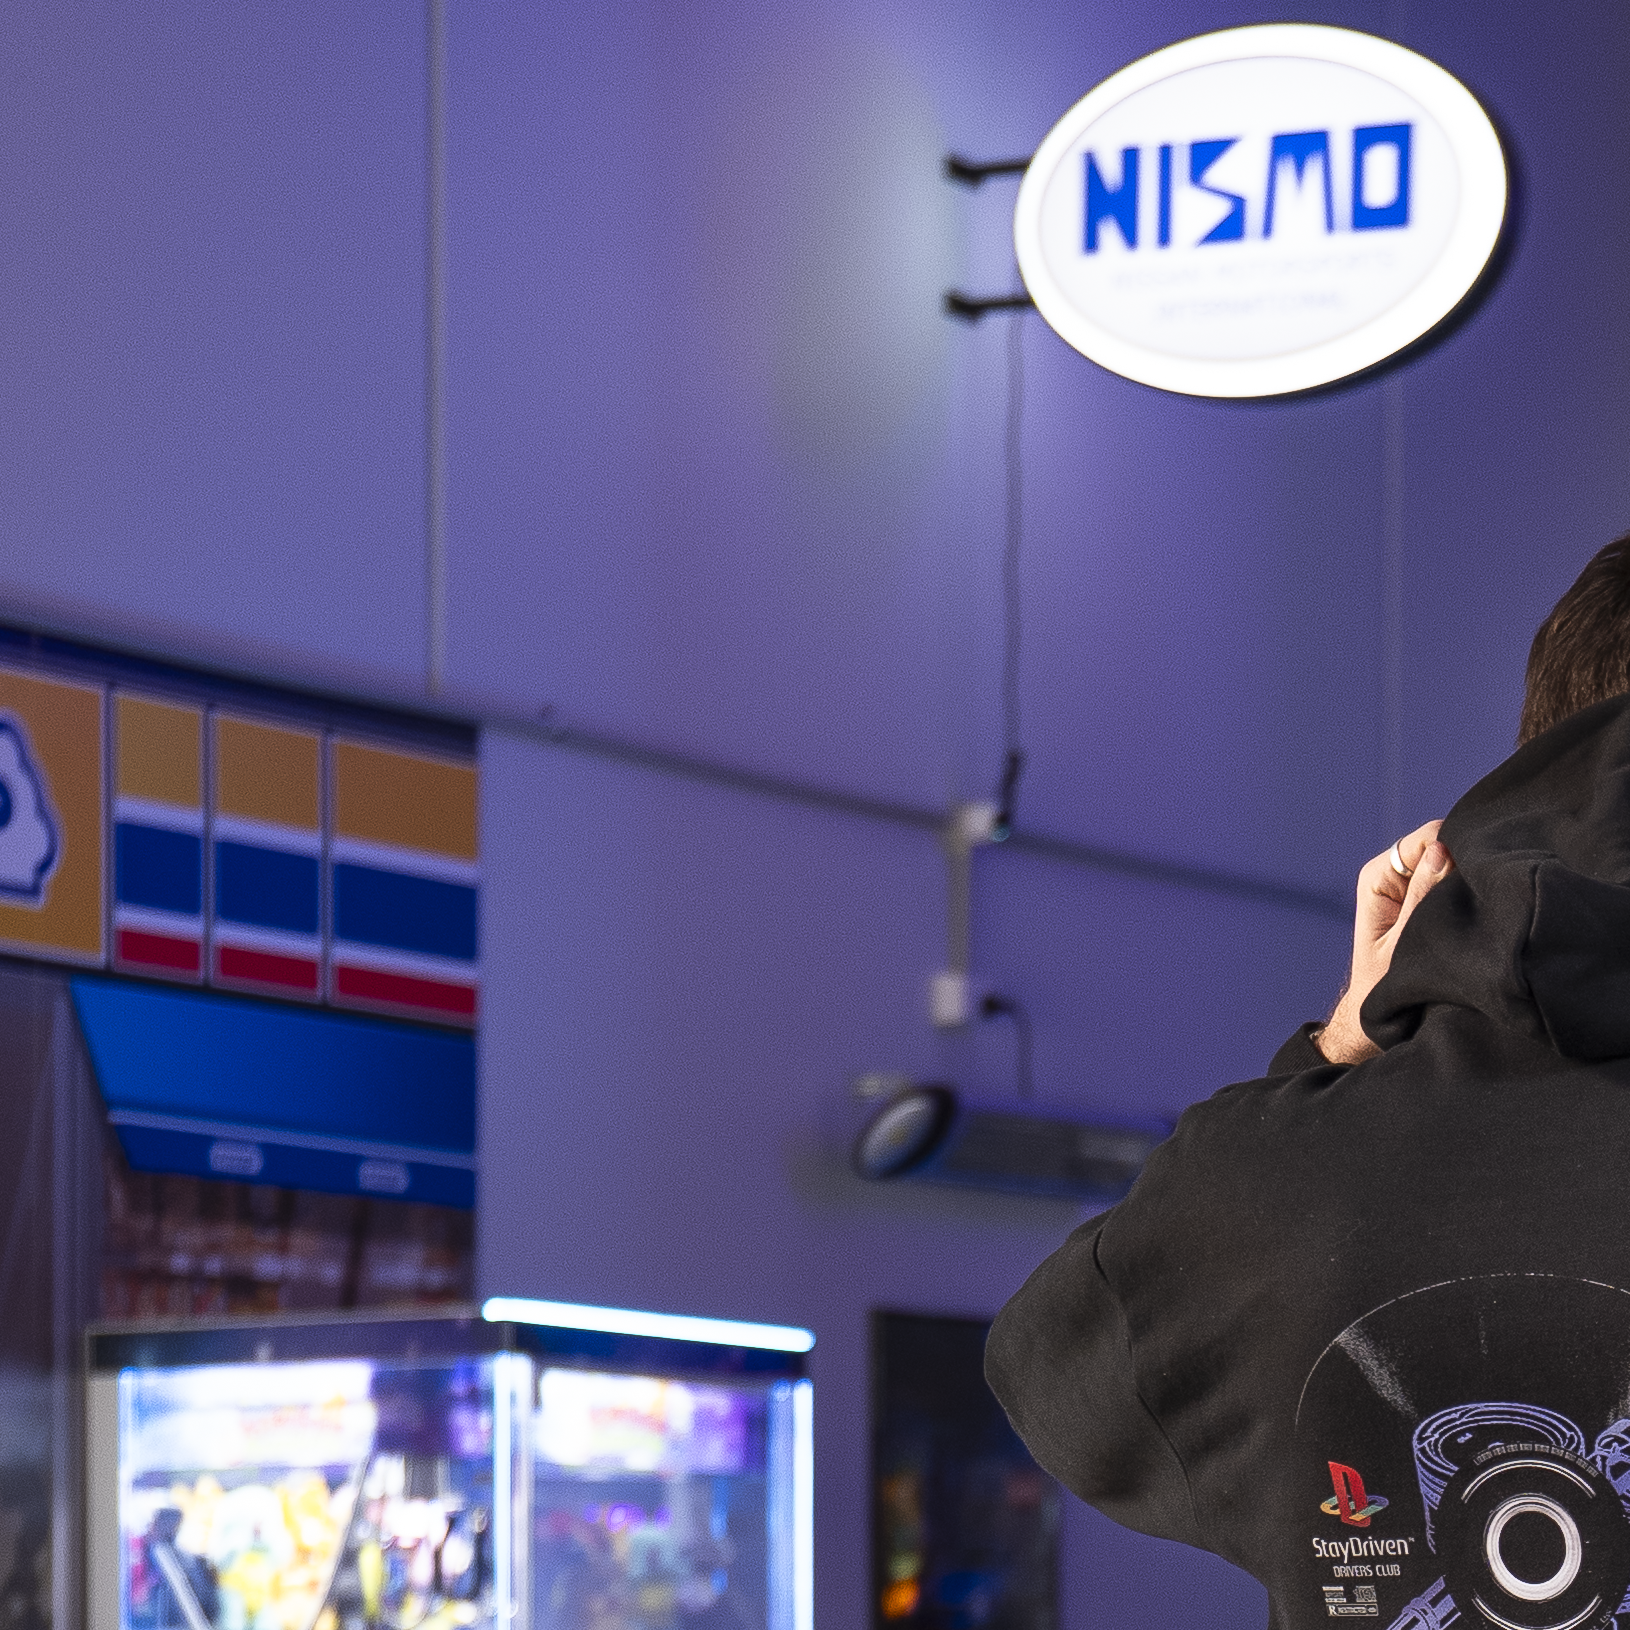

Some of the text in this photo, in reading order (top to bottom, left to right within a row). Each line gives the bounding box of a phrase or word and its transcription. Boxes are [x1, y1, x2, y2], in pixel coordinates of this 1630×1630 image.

[1082, 121, 1417, 256] NISMO
[1333, 1563, 1401, 1577] DRIVERS CLUB
